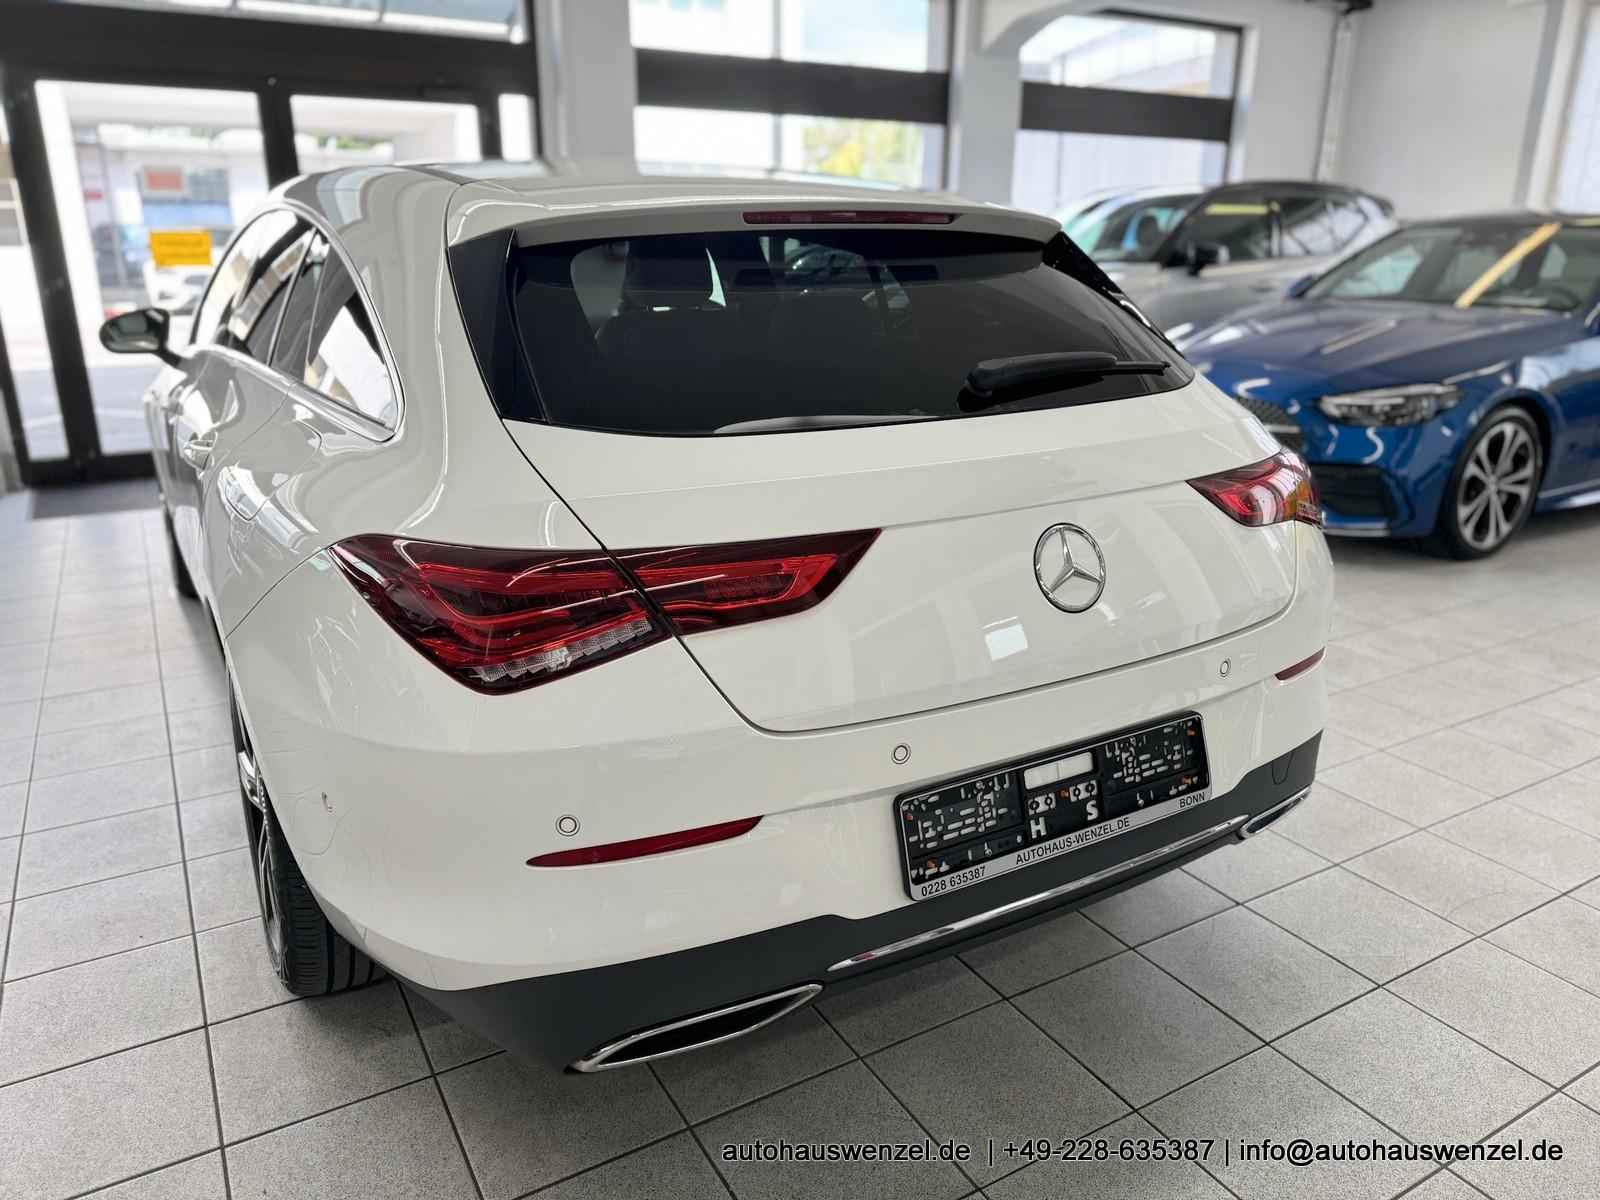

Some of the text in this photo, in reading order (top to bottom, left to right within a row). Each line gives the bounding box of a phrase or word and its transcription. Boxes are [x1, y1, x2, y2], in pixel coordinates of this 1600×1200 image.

[921, 791, 1206, 897] 0228 635387 AUTOHAUS-WENZEL.DE BONN
